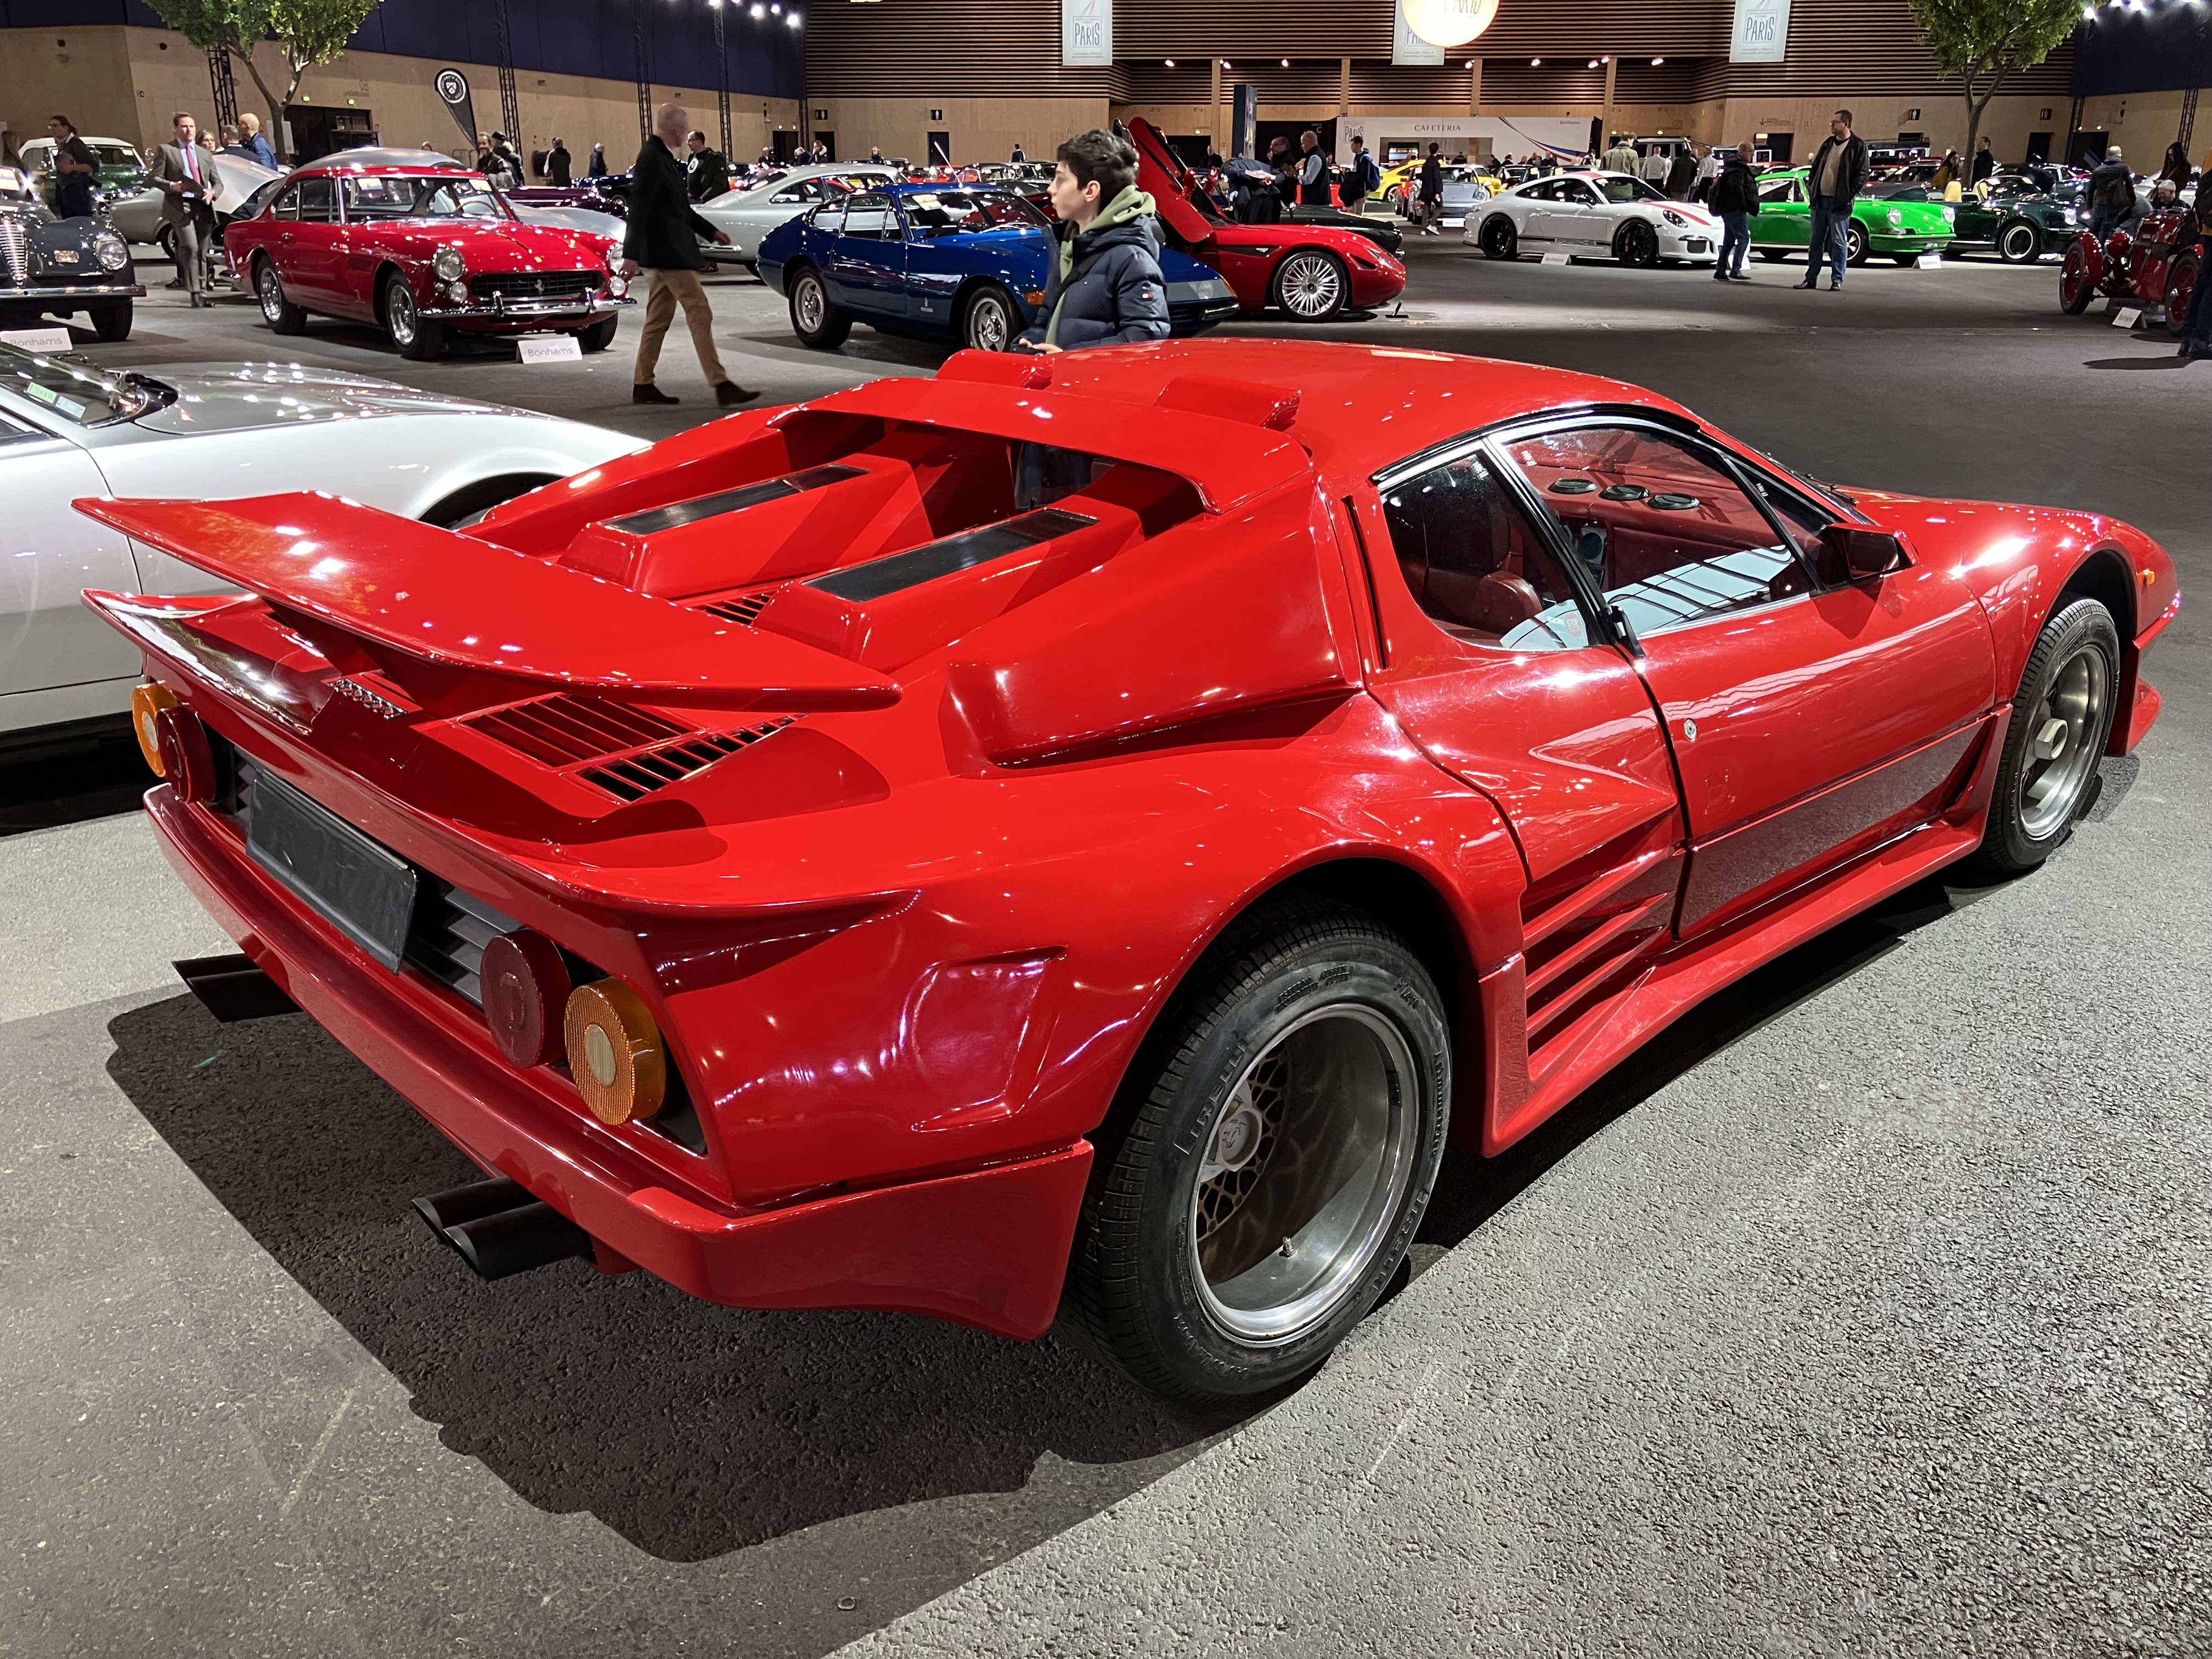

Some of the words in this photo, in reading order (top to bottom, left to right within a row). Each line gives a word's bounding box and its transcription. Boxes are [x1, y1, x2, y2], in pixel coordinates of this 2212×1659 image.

[1075, 23, 1099, 46] PARIS
[1745, 16, 1774, 41] PARIS
[10, 338, 63, 347] Bonhams
[528, 347, 573, 357] Bonhams
[1566, 618, 1579, 628] STOP
[1173, 1031, 1246, 1155] PIRELLI
